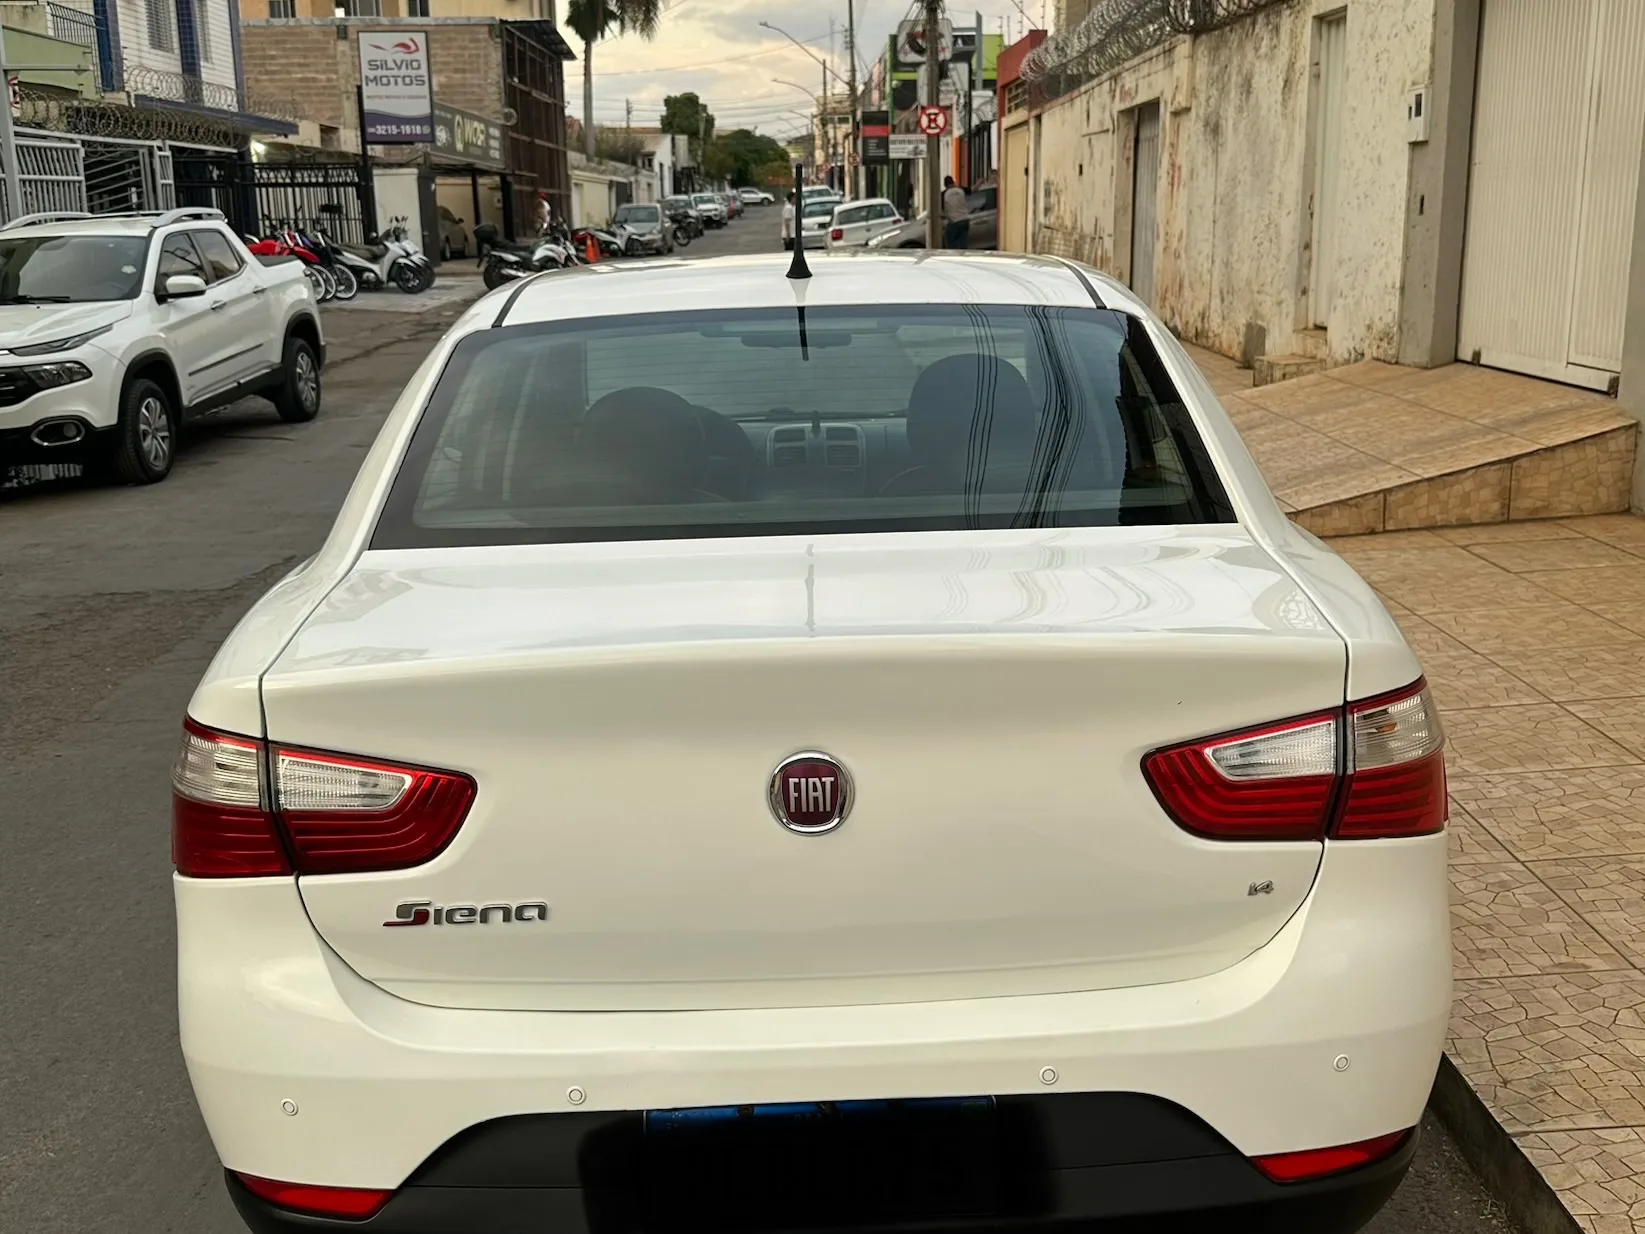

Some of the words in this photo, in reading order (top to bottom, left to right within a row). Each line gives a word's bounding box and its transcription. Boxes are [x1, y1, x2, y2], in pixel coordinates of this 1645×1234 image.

[364, 75, 427, 87] MOTOS
[788, 776, 835, 813] FIAT
[382, 900, 548, 928] Siena
